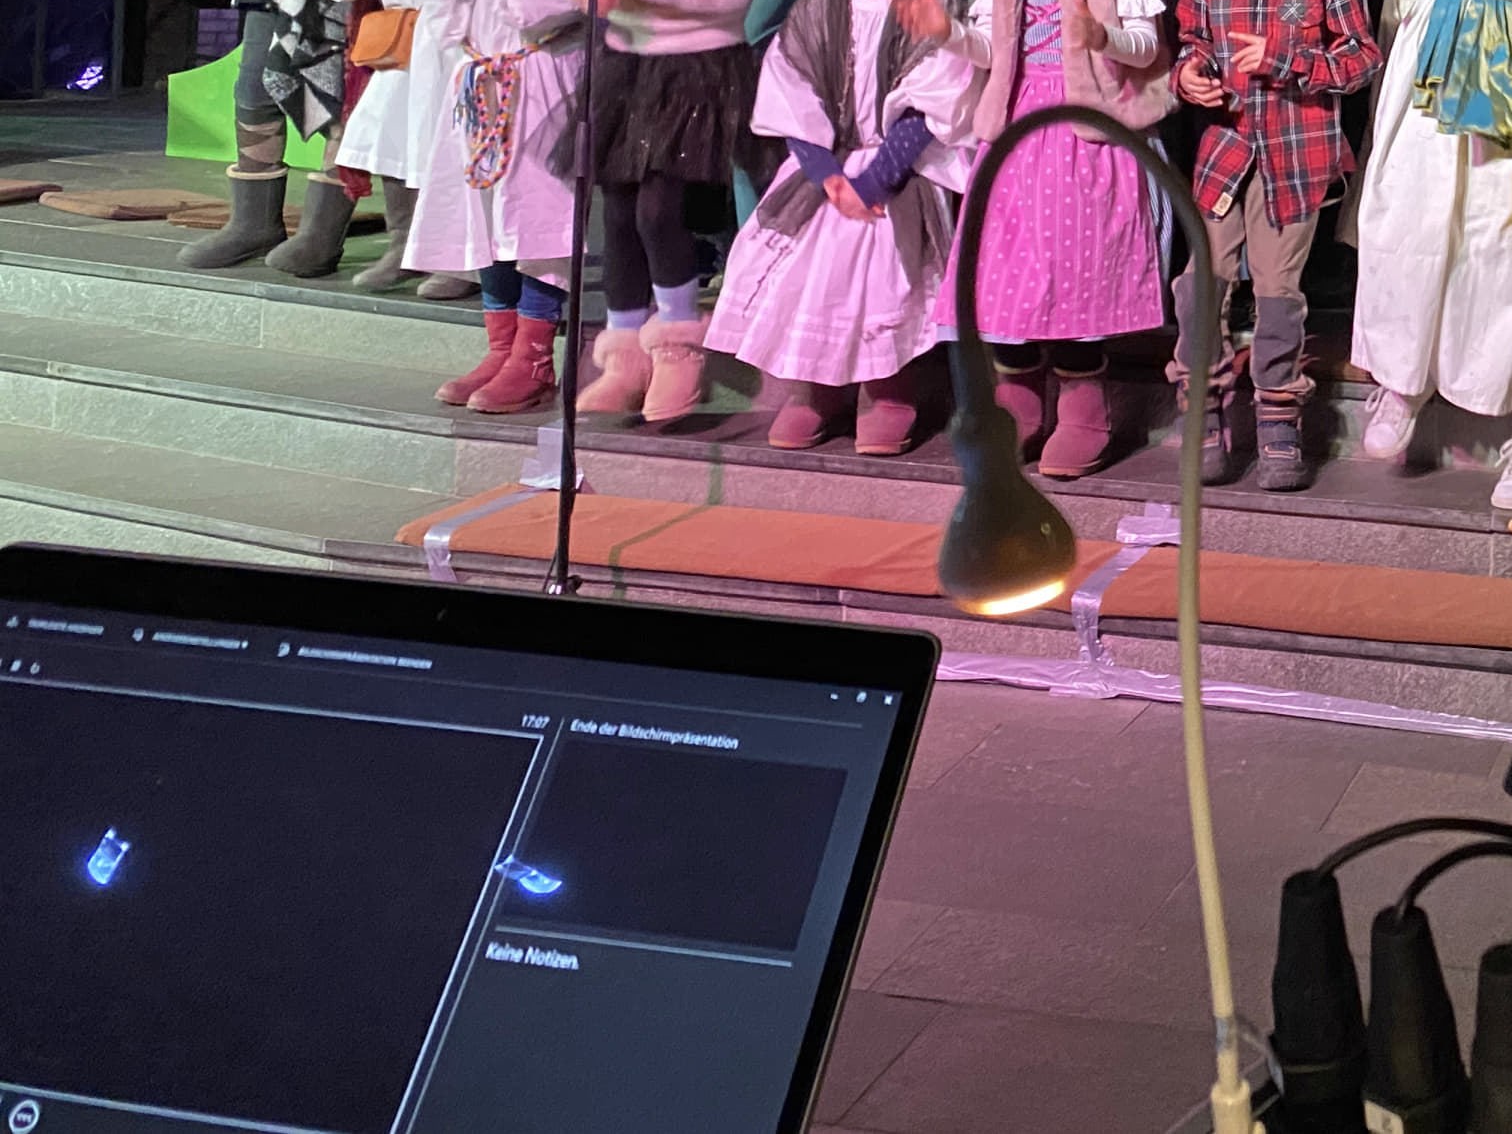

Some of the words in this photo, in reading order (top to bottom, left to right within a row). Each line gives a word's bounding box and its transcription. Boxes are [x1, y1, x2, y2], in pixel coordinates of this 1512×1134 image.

[570, 718, 598, 735] Ende
[598, 722, 618, 737] der
[617, 724, 740, 750] Bildschirmpräsentation
[485, 941, 525, 963] Keine
